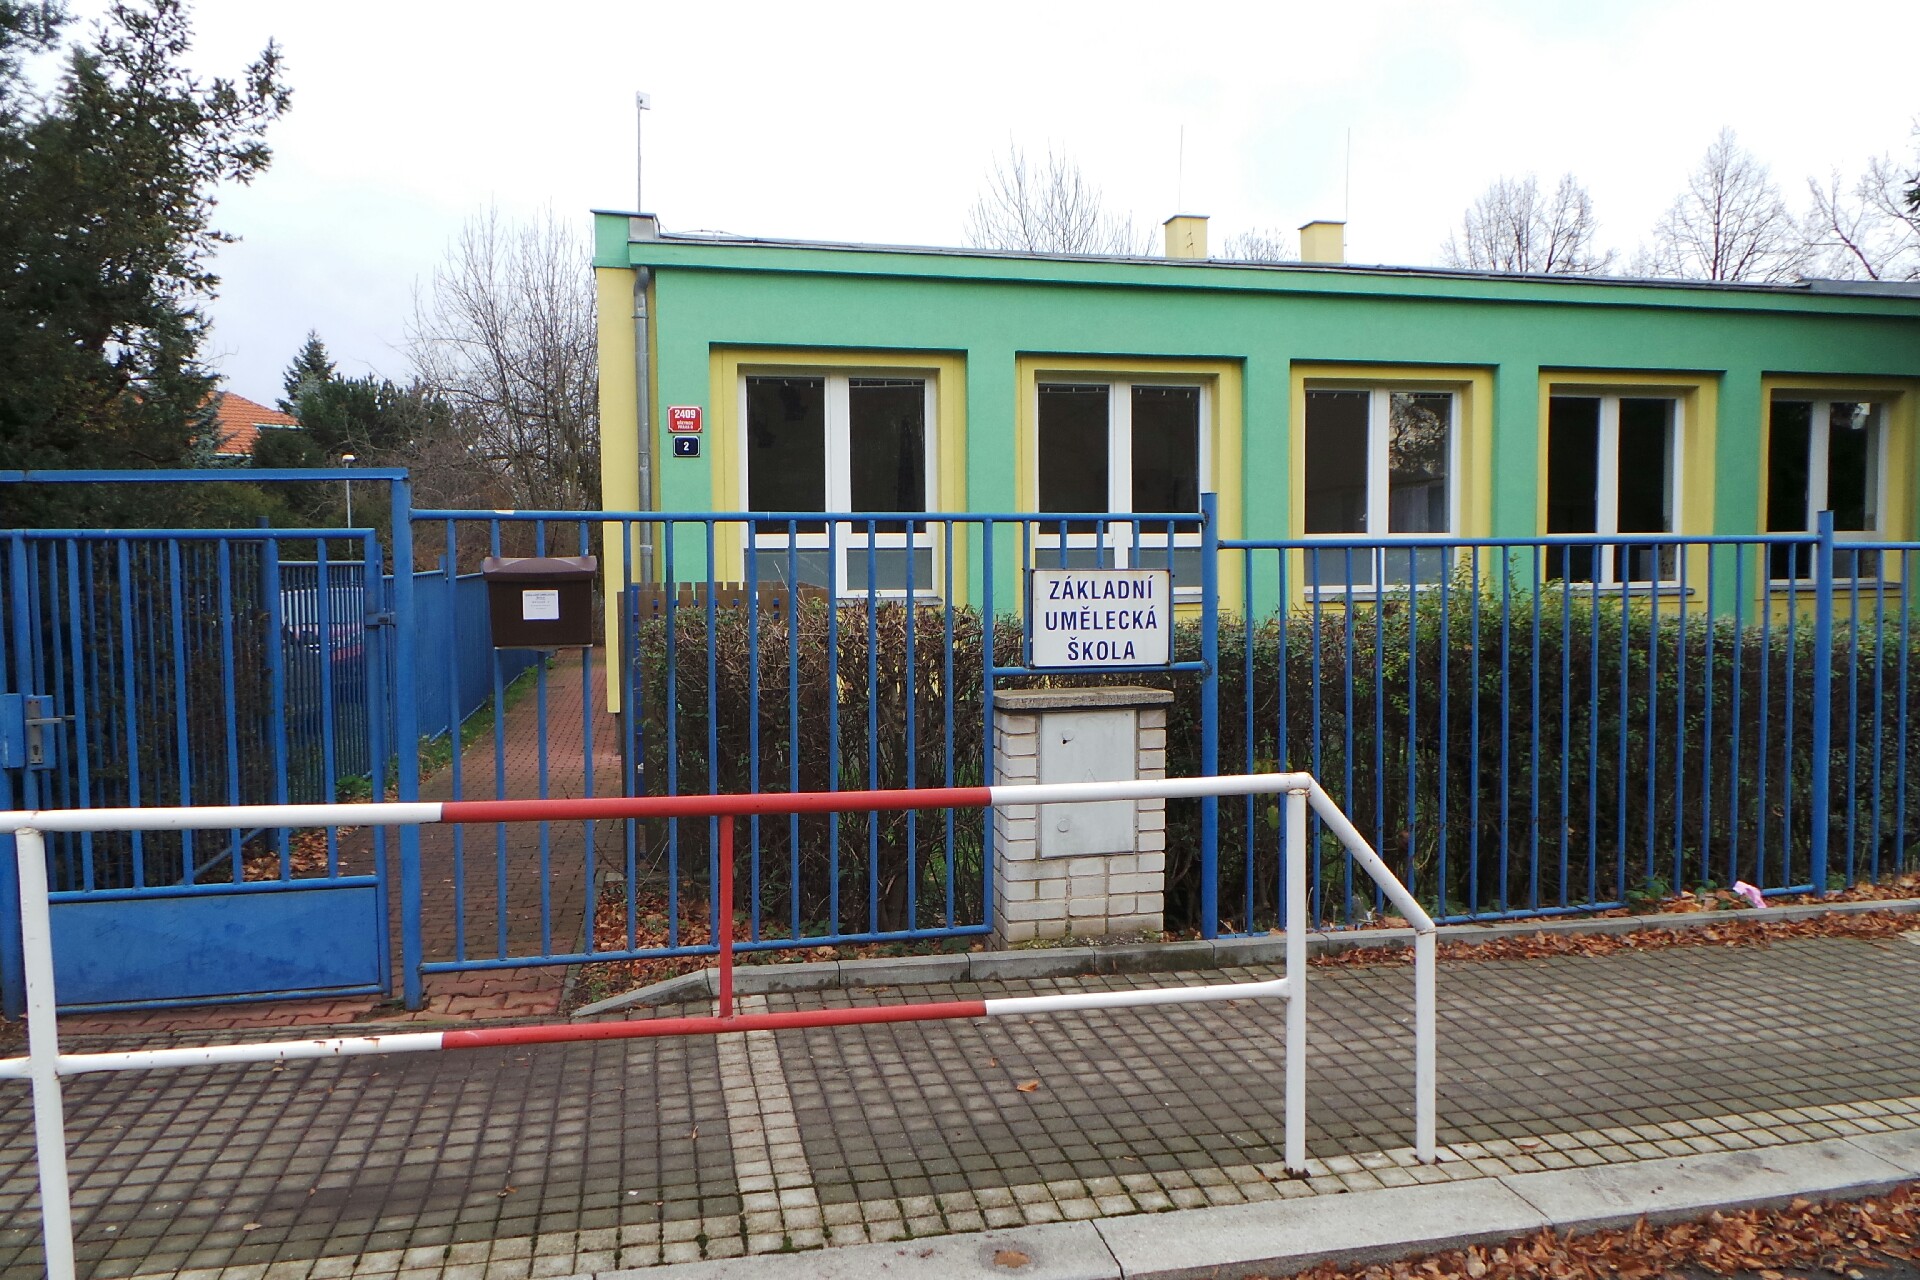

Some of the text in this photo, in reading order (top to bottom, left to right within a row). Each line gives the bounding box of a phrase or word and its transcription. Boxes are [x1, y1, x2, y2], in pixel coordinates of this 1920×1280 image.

[674, 409, 696, 419] 2409
[683, 441, 690, 451] 2
[1049, 575, 1154, 600] ZÁKLADNÍ
[1045, 605, 1158, 630] UMĚLECKÁ
[1067, 636, 1136, 661] ŠKOLA
